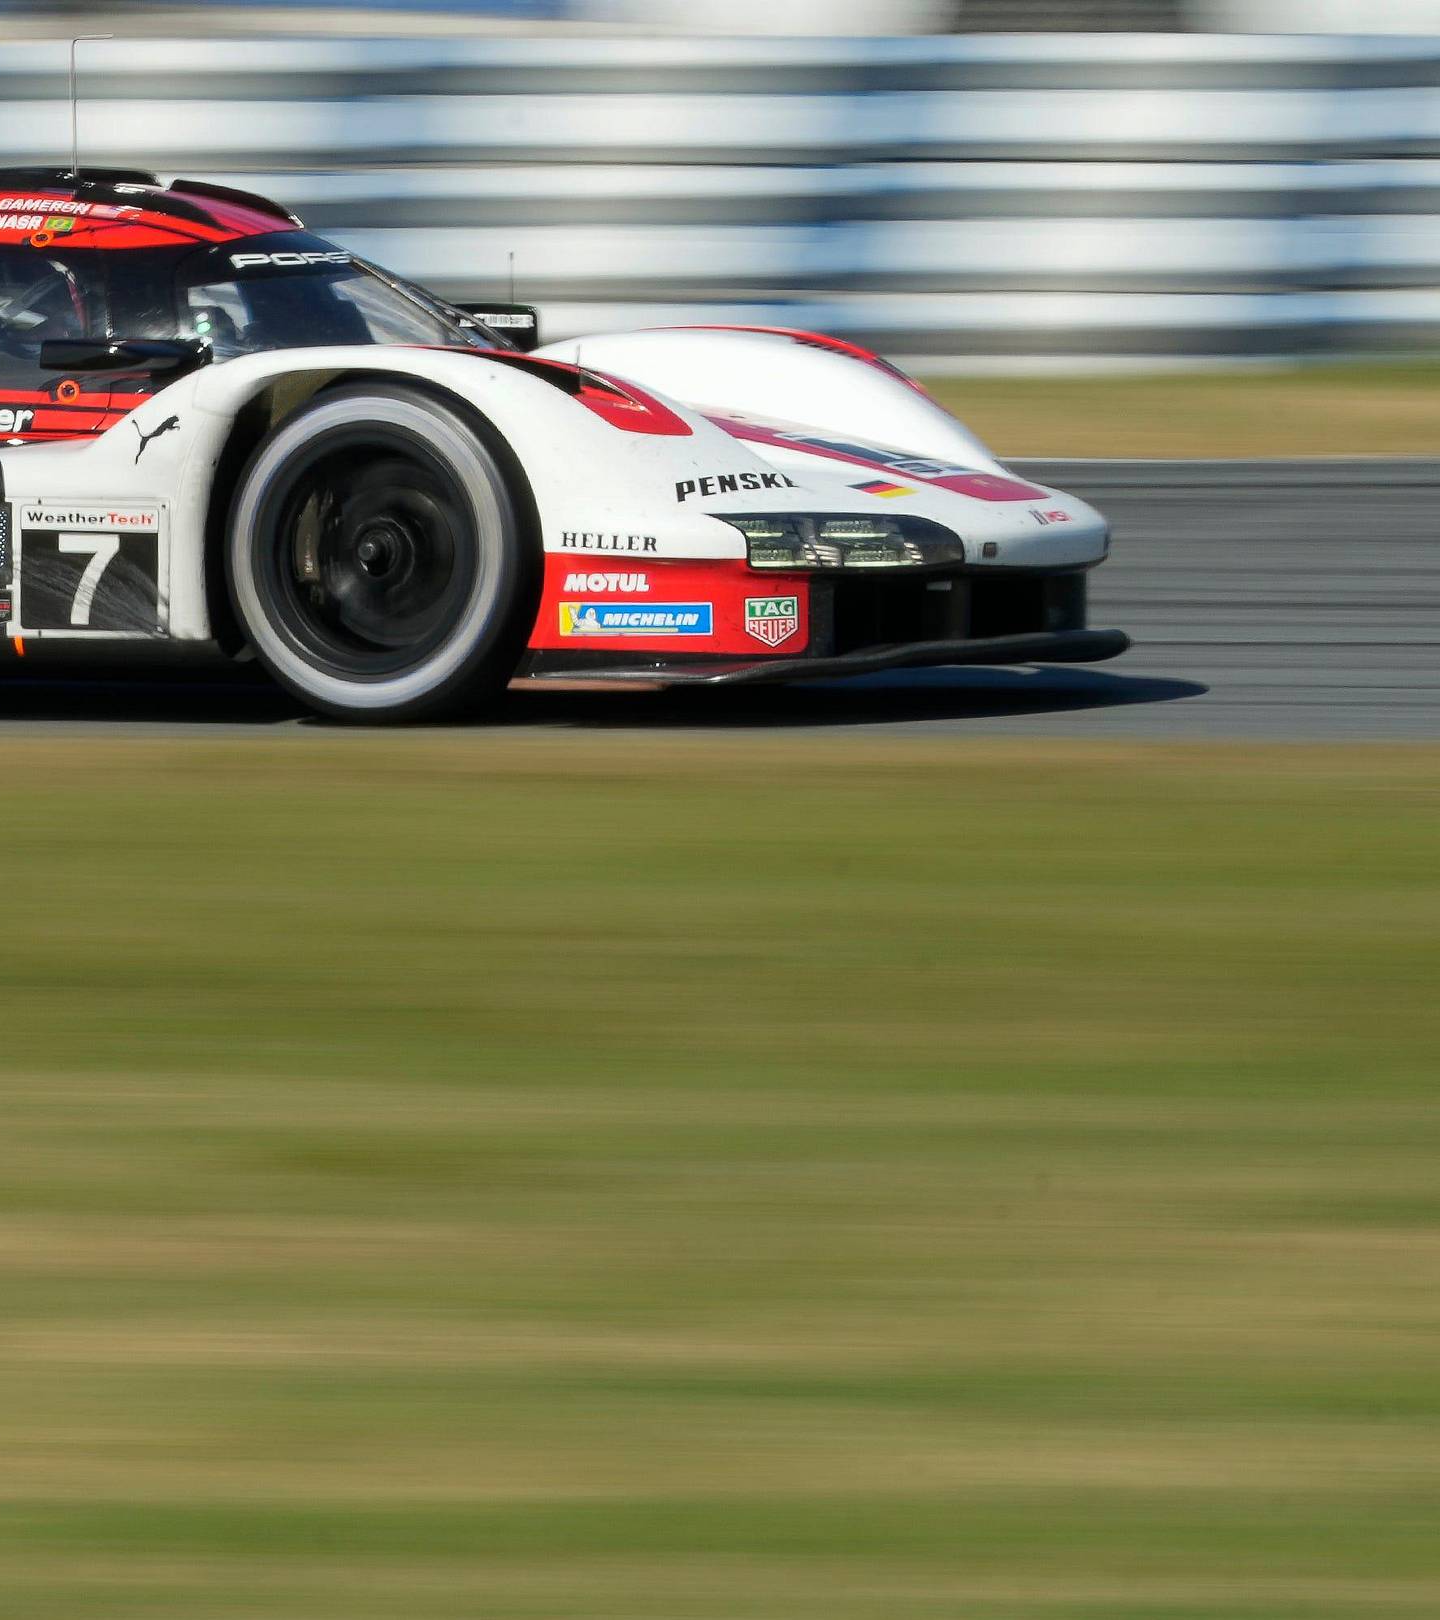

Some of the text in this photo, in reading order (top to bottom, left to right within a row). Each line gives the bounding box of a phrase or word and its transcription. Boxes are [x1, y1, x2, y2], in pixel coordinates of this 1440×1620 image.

[27, 511, 153, 525] WeatherTech
[562, 531, 658, 552] HELLER
[58, 533, 121, 626] 7
[563, 573, 650, 592] MOTUL
[749, 601, 794, 616] TAG
[602, 612, 700, 627] MICHELIN
[748, 619, 796, 644] HEUER
